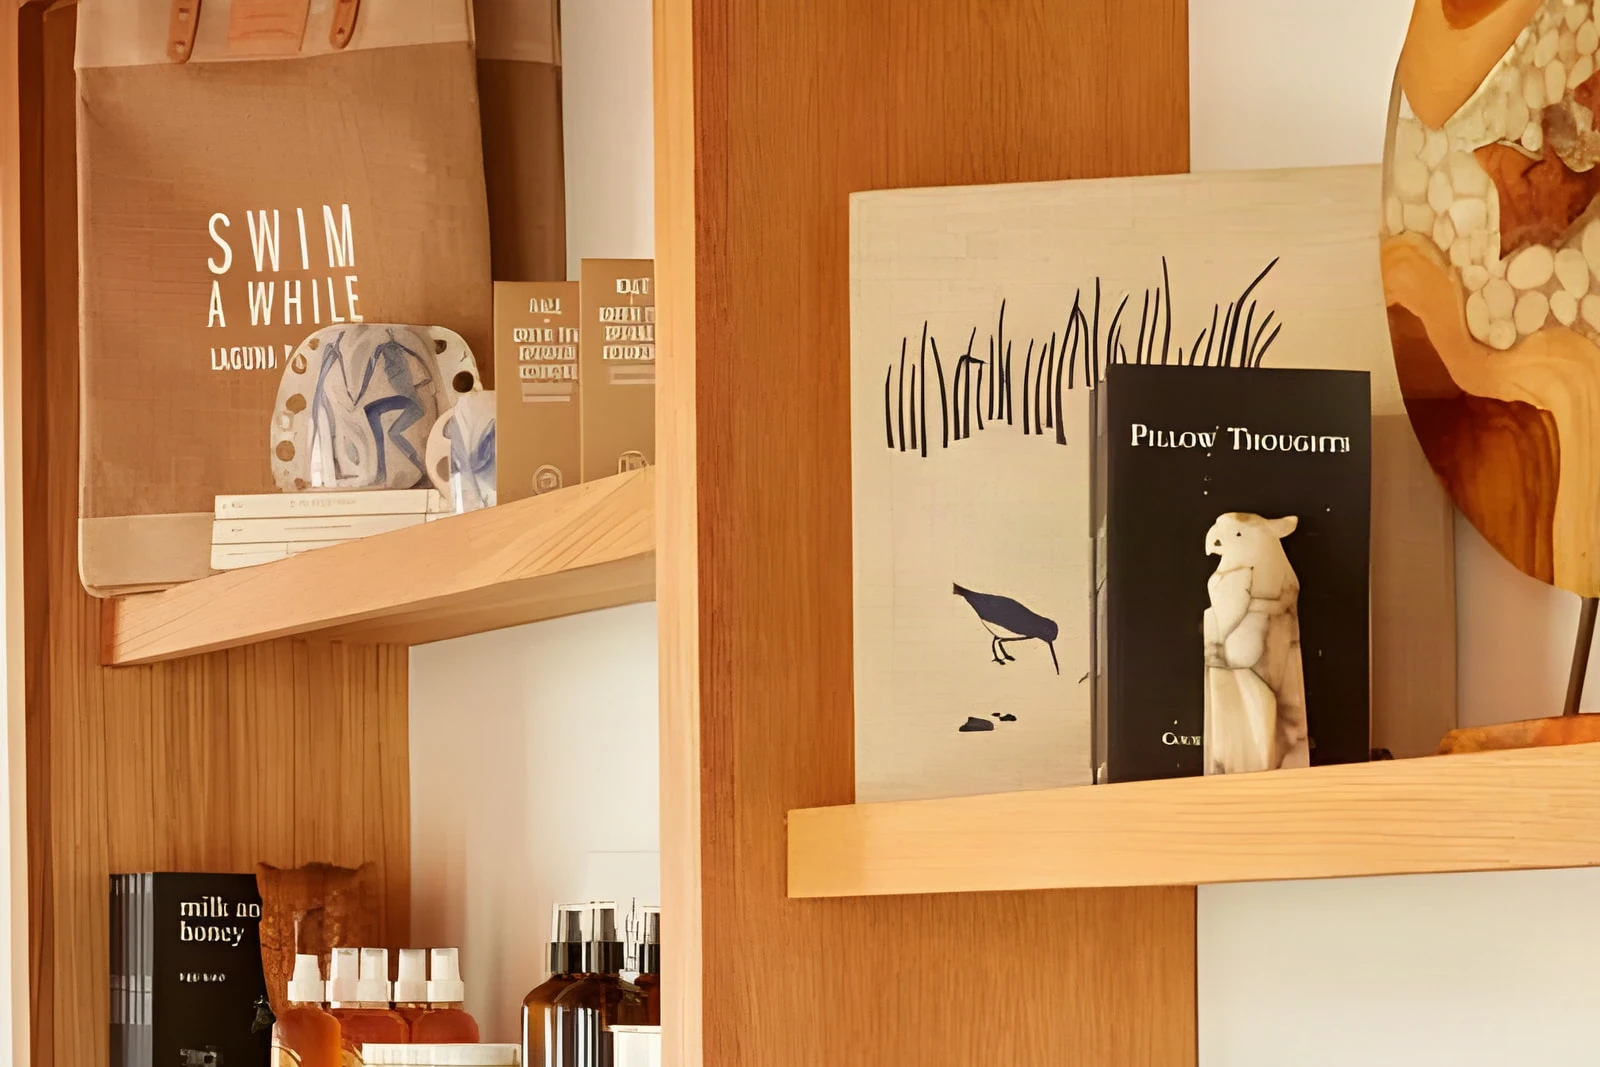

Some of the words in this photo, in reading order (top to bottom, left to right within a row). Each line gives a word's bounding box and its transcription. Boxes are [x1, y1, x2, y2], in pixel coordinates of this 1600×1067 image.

[207, 203, 355, 275] SWIM
[206, 280, 227, 328] A
[247, 275, 364, 326] WHILE
[180, 896, 229, 917] milk
